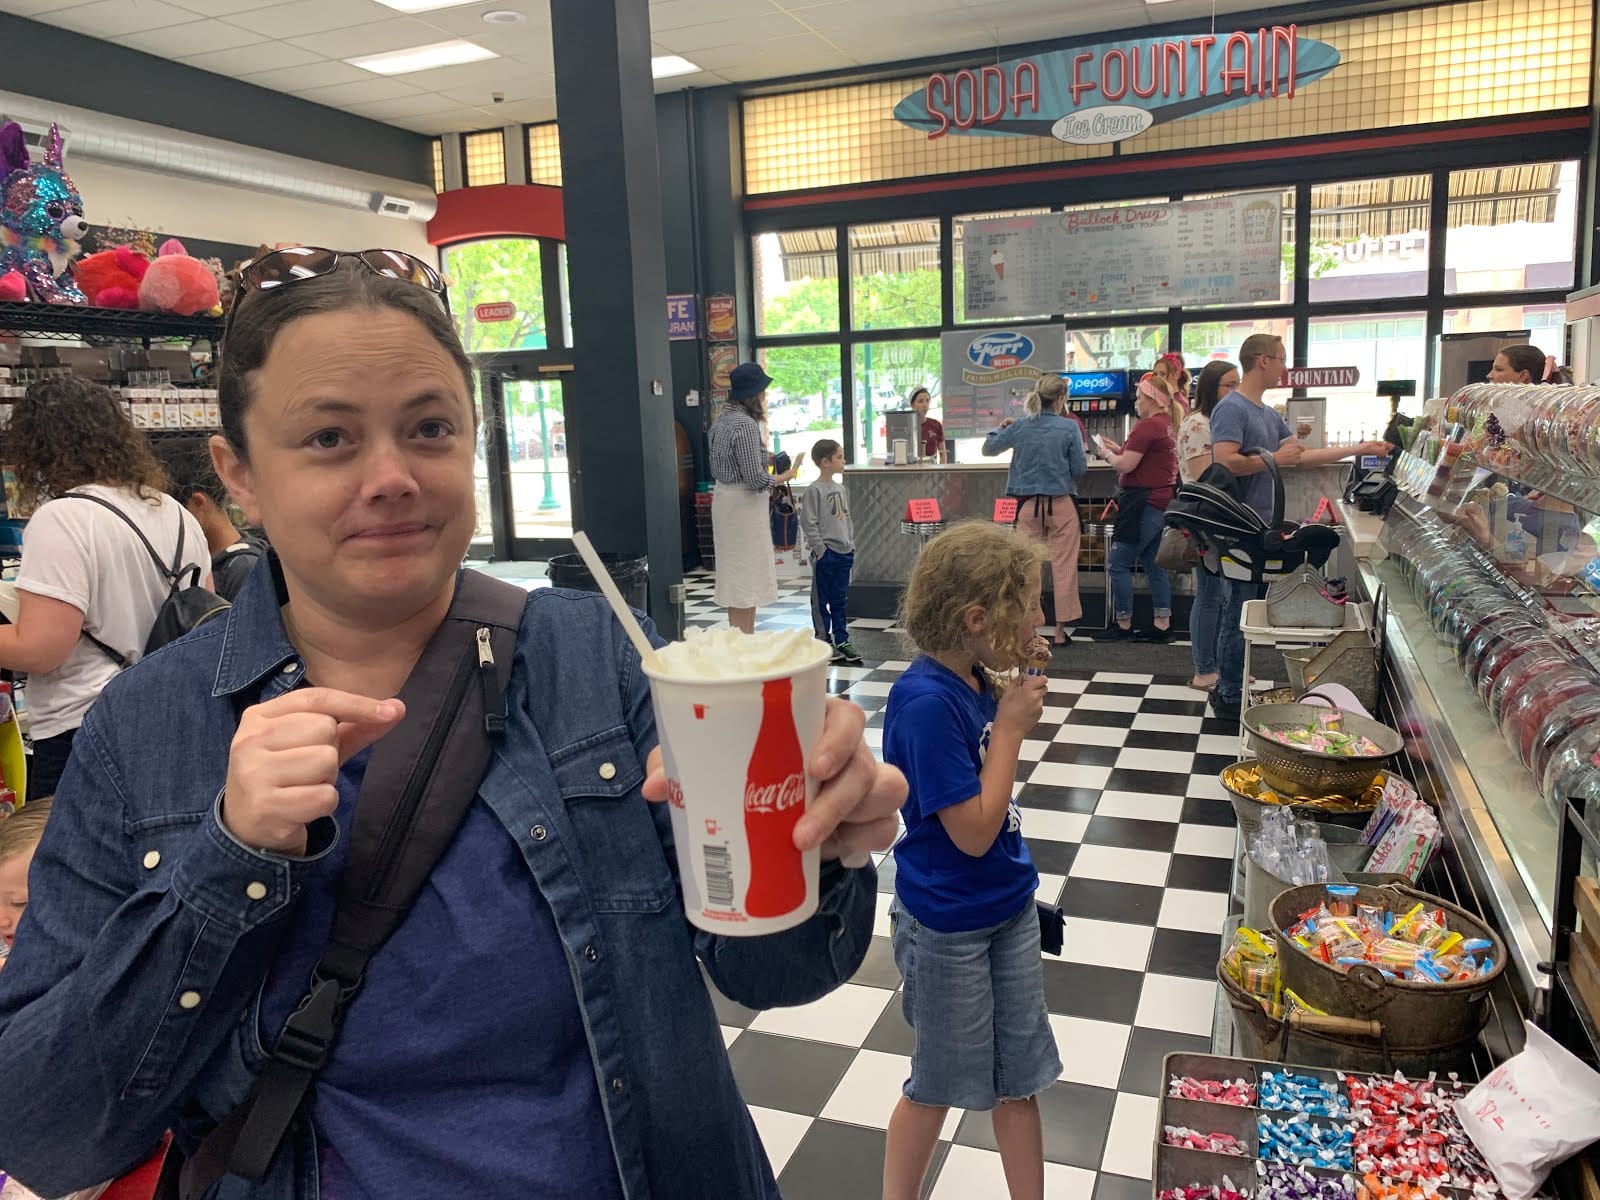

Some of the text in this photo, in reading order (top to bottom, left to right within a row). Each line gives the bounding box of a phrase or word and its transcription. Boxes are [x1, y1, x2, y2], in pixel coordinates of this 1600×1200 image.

[926, 24, 1298, 140] SODA FOUNTAIN
[1063, 112, 1145, 140] Ice Cream
[479, 306, 511, 318] LEADER
[972, 332, 1025, 366] Farr
[993, 358, 1016, 366] BETTER
[1074, 376, 1110, 390] pepsi
[1287, 367, 1354, 386] FOUNTAIN
